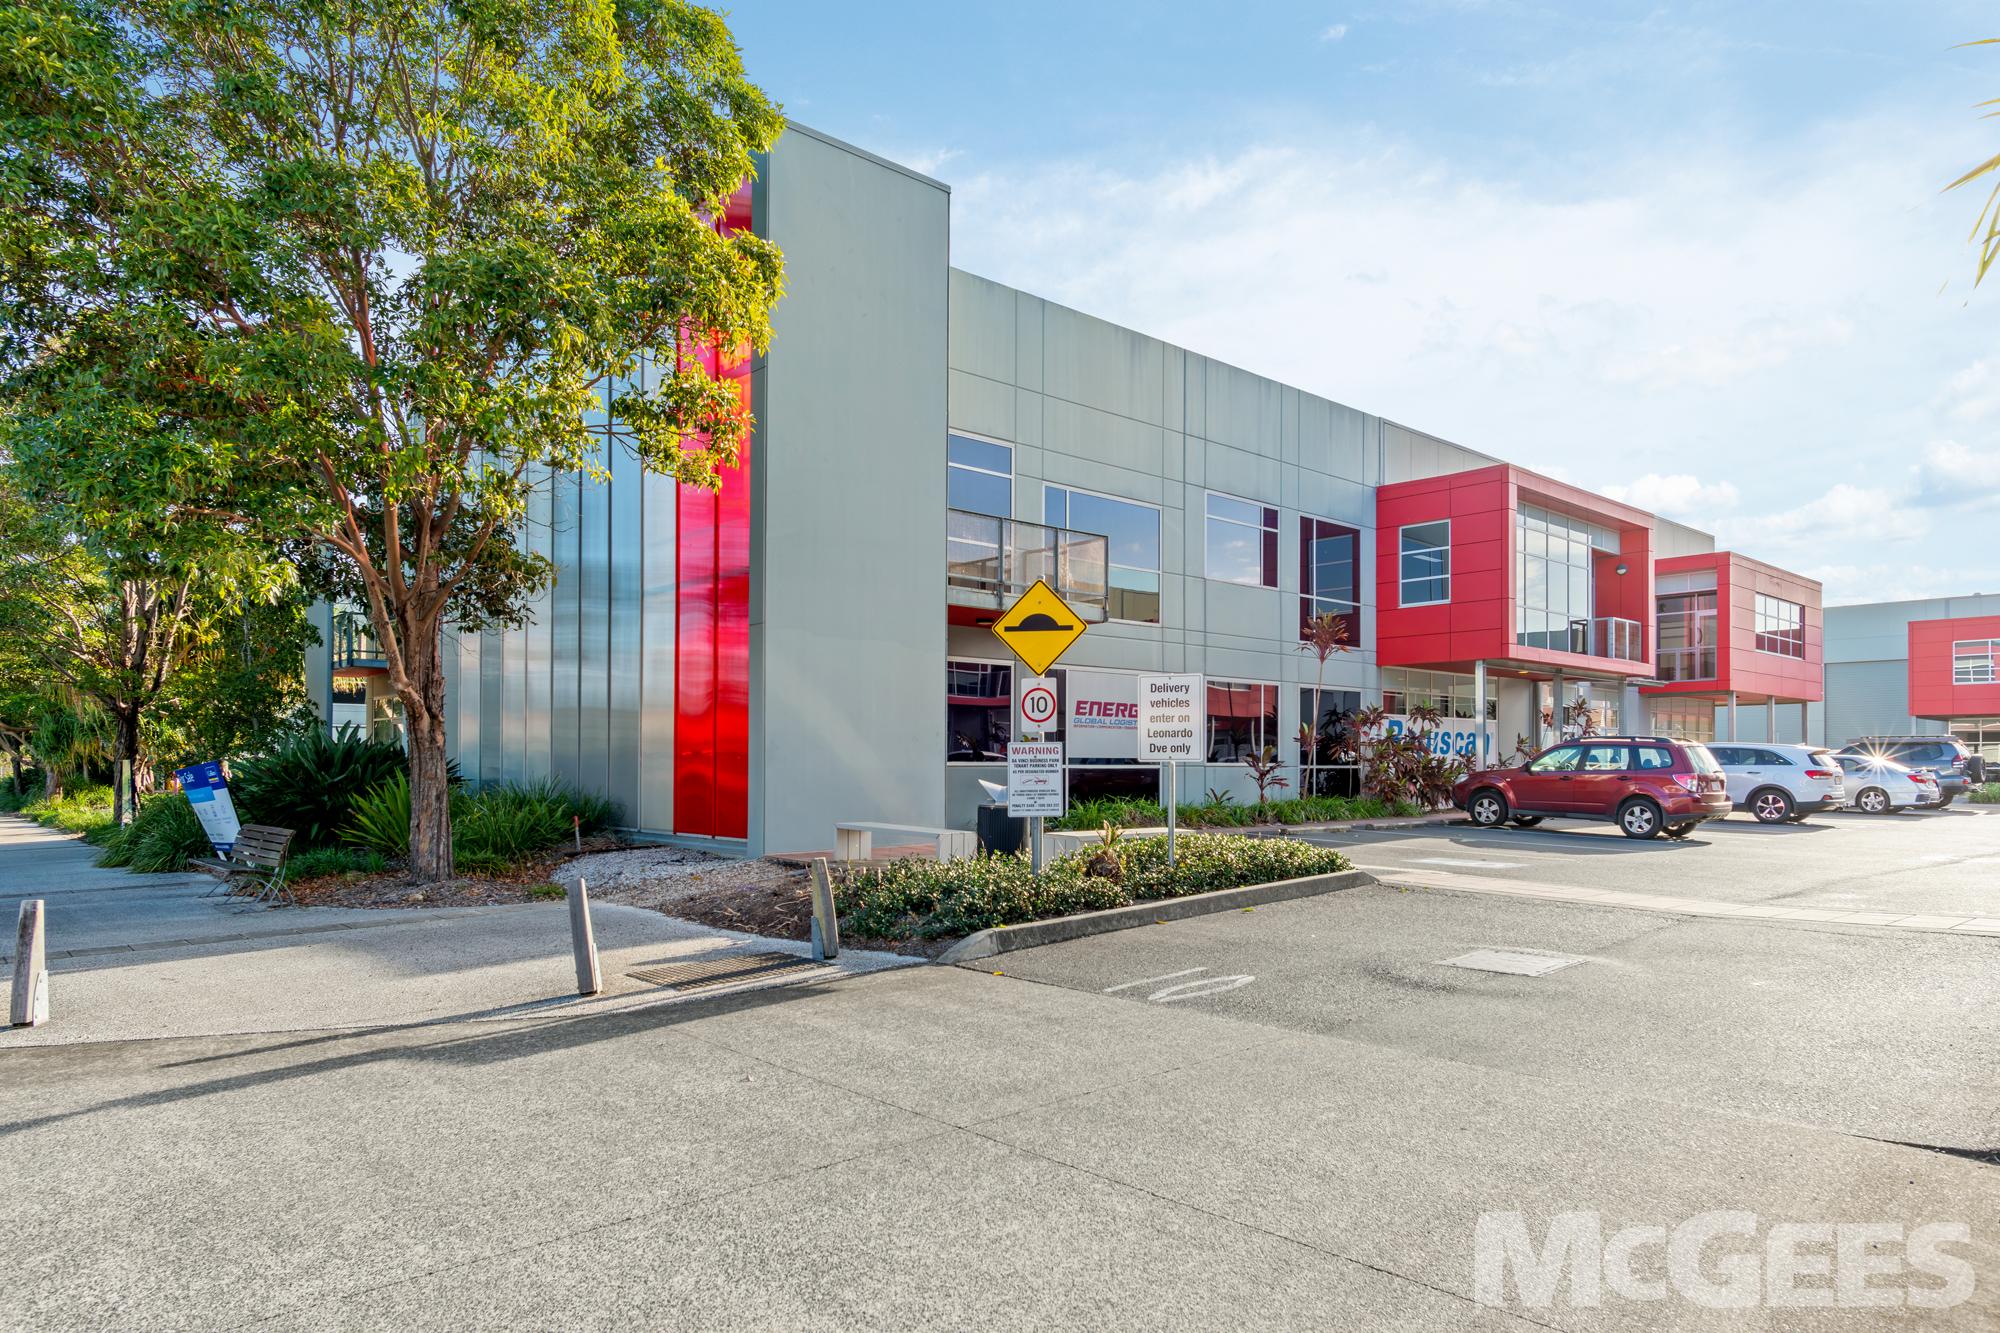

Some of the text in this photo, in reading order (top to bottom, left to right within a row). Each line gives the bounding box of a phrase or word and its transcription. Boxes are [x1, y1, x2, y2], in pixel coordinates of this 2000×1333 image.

[1150, 683, 1190, 695] Delivery
[1029, 696, 1048, 714] 10
[1150, 697, 1190, 708] vehicles
[1073, 717, 1107, 725] GLOBAL
[1150, 714, 1190, 723] enter on
[1147, 728, 1193, 738] Leonardo
[1011, 746, 1059, 755] WARNING
[1150, 743, 1191, 755] Dve only
